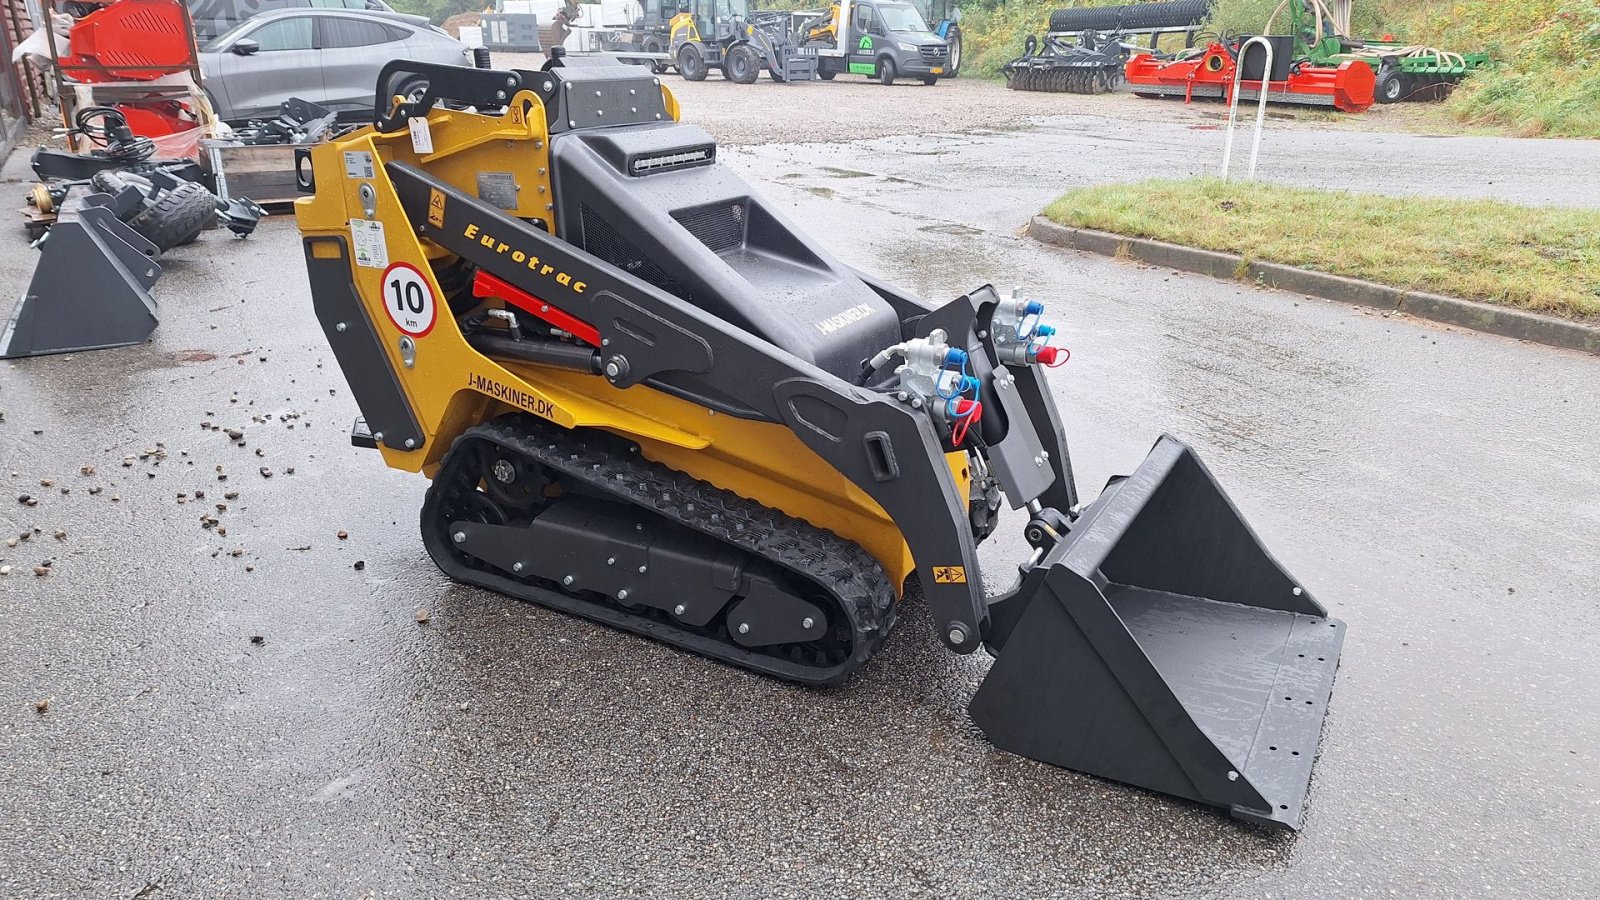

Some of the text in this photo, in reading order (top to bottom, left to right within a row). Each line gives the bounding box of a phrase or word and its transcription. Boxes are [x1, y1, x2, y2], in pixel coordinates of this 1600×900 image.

[463, 223, 588, 294] Eurotrac
[390, 279, 425, 314] 10
[405, 317, 418, 328] km
[468, 372, 554, 418] J-MASKINER.DK
